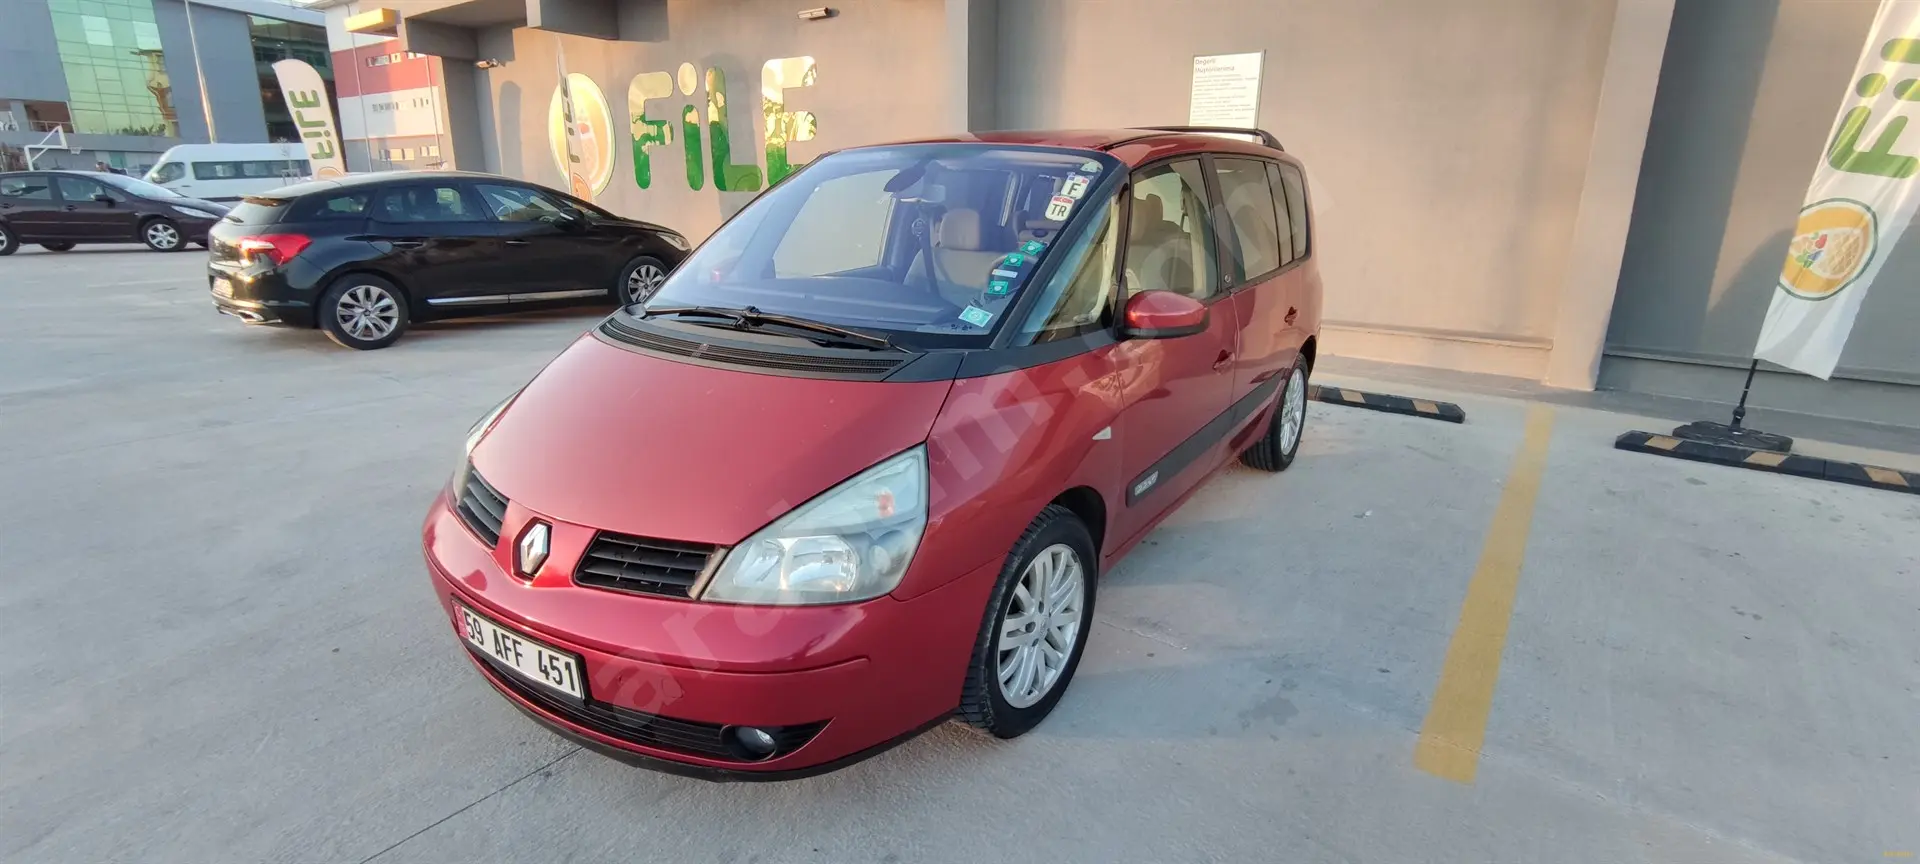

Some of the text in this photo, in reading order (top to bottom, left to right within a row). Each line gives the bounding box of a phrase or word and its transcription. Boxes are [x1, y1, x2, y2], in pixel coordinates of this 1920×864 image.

[1067, 182, 1082, 195] F
[1051, 203, 1068, 217] TR
[463, 610, 576, 692] 59 AFF 451
